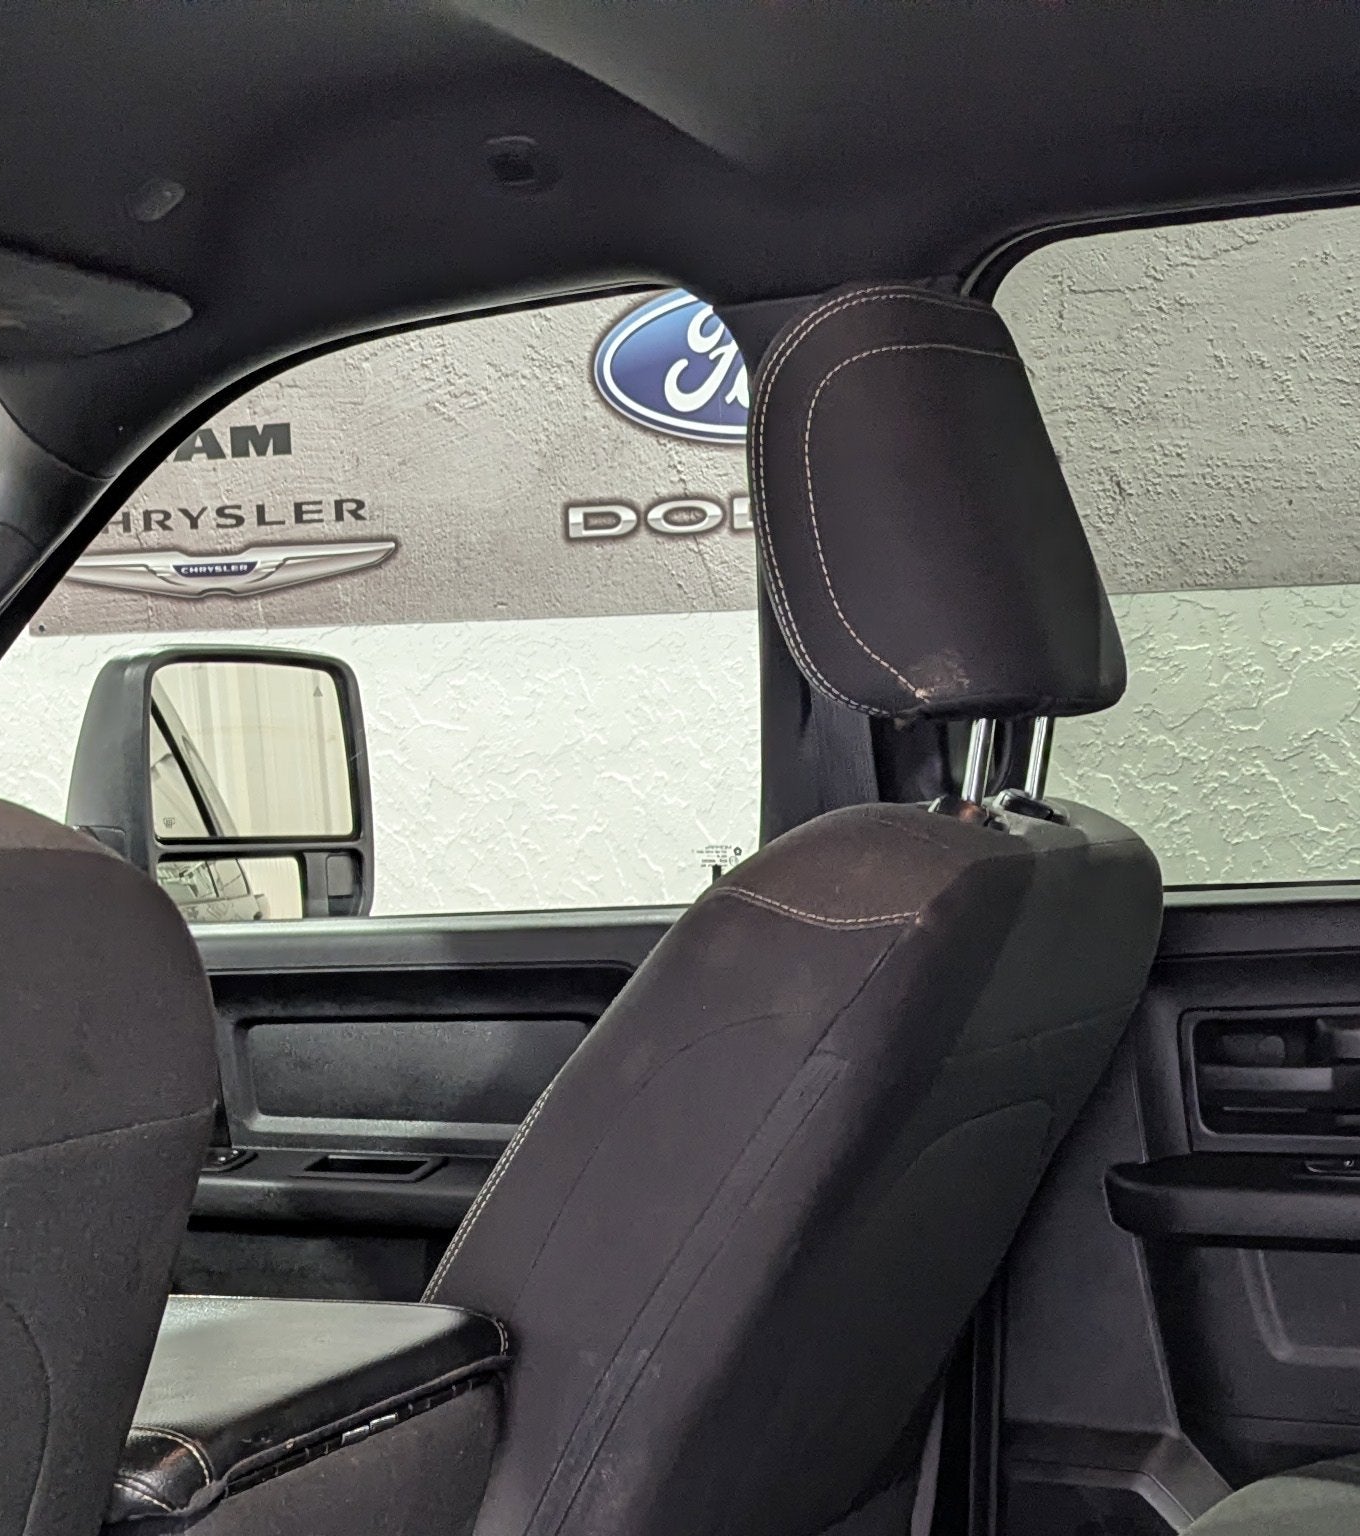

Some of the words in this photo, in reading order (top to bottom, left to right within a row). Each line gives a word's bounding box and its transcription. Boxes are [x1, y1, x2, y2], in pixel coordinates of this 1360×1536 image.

[166, 422, 293, 463] AM
[101, 498, 368, 535] HRYSLER
[180, 564, 248, 575] CHRYSLER
